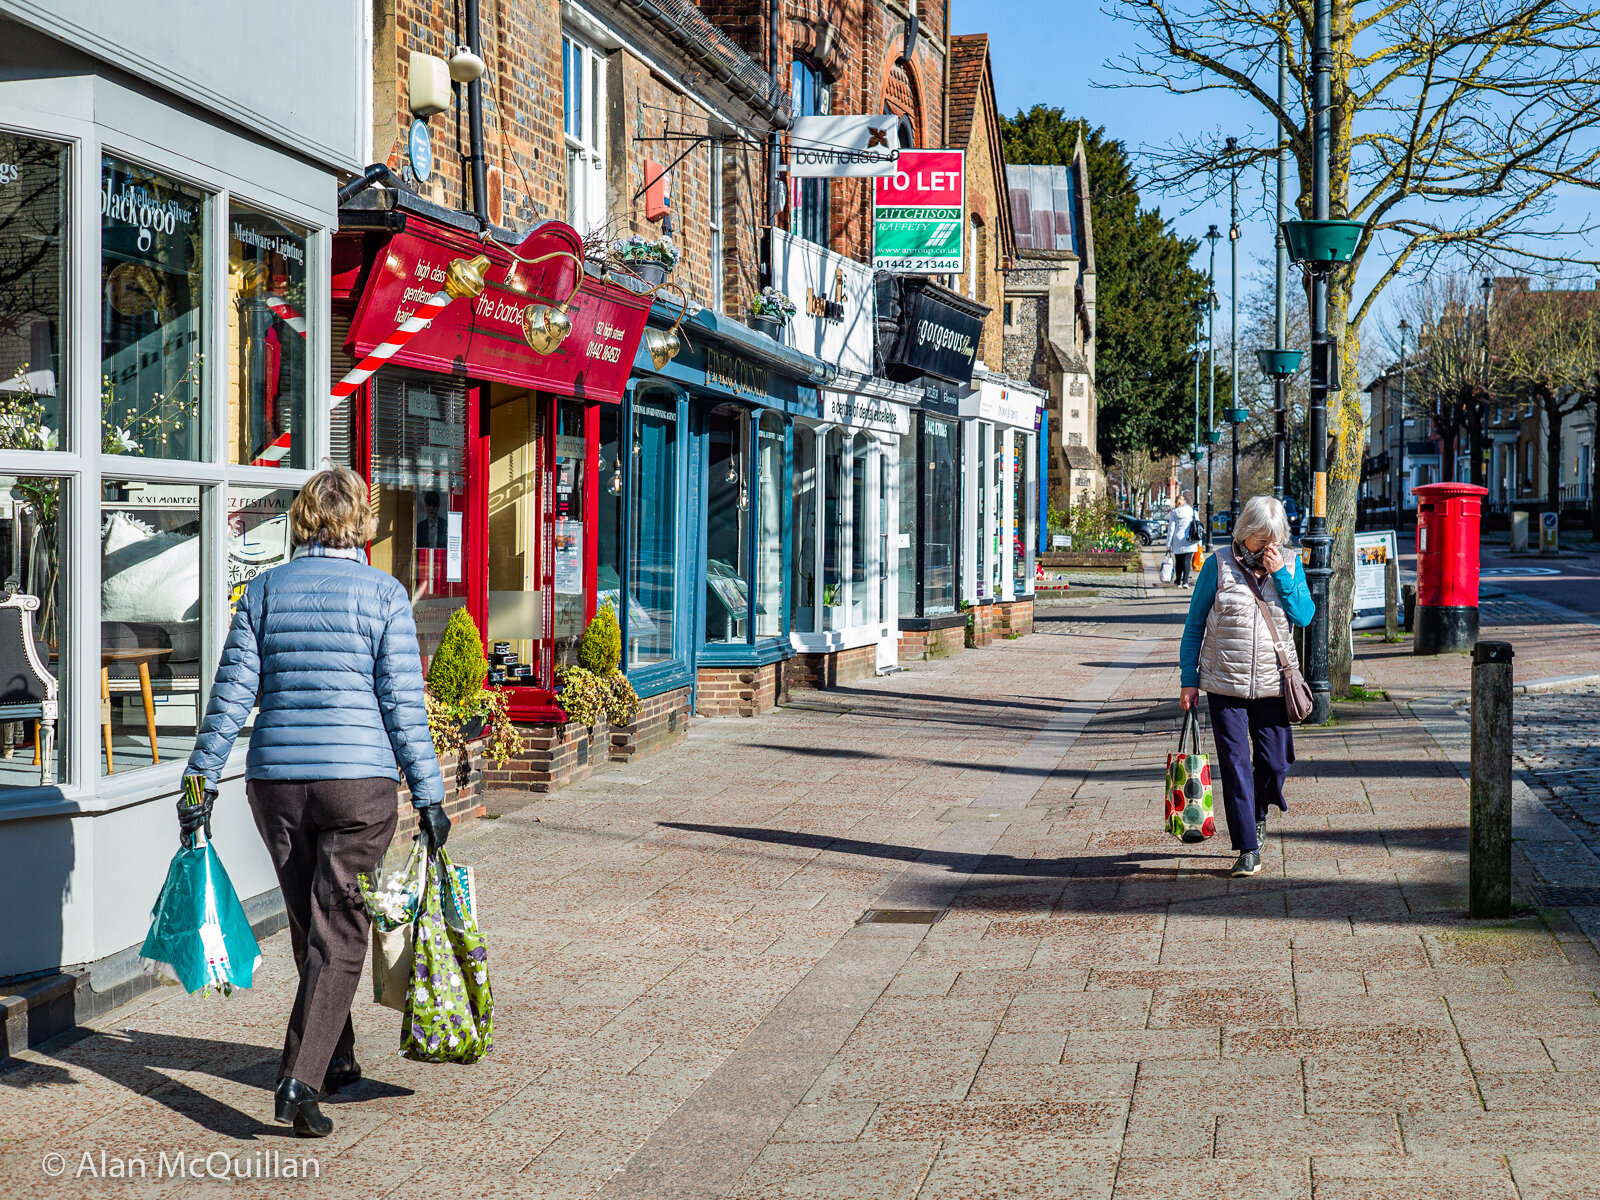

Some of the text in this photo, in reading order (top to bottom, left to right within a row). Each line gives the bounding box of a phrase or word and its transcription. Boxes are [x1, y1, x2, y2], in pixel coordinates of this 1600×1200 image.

[917, 171, 960, 191] LET
[878, 208, 959, 219] AITCHISON
[878, 222, 931, 231] RAFFETY
[234, 221, 304, 266] Metalware Lighting
[414, 258, 447, 284] high class
[876, 259, 959, 269] 01442 213446
[475, 292, 495, 318] the
[918, 319, 964, 353] gorgeous
[239, 498, 288, 508] FESTIVAL
